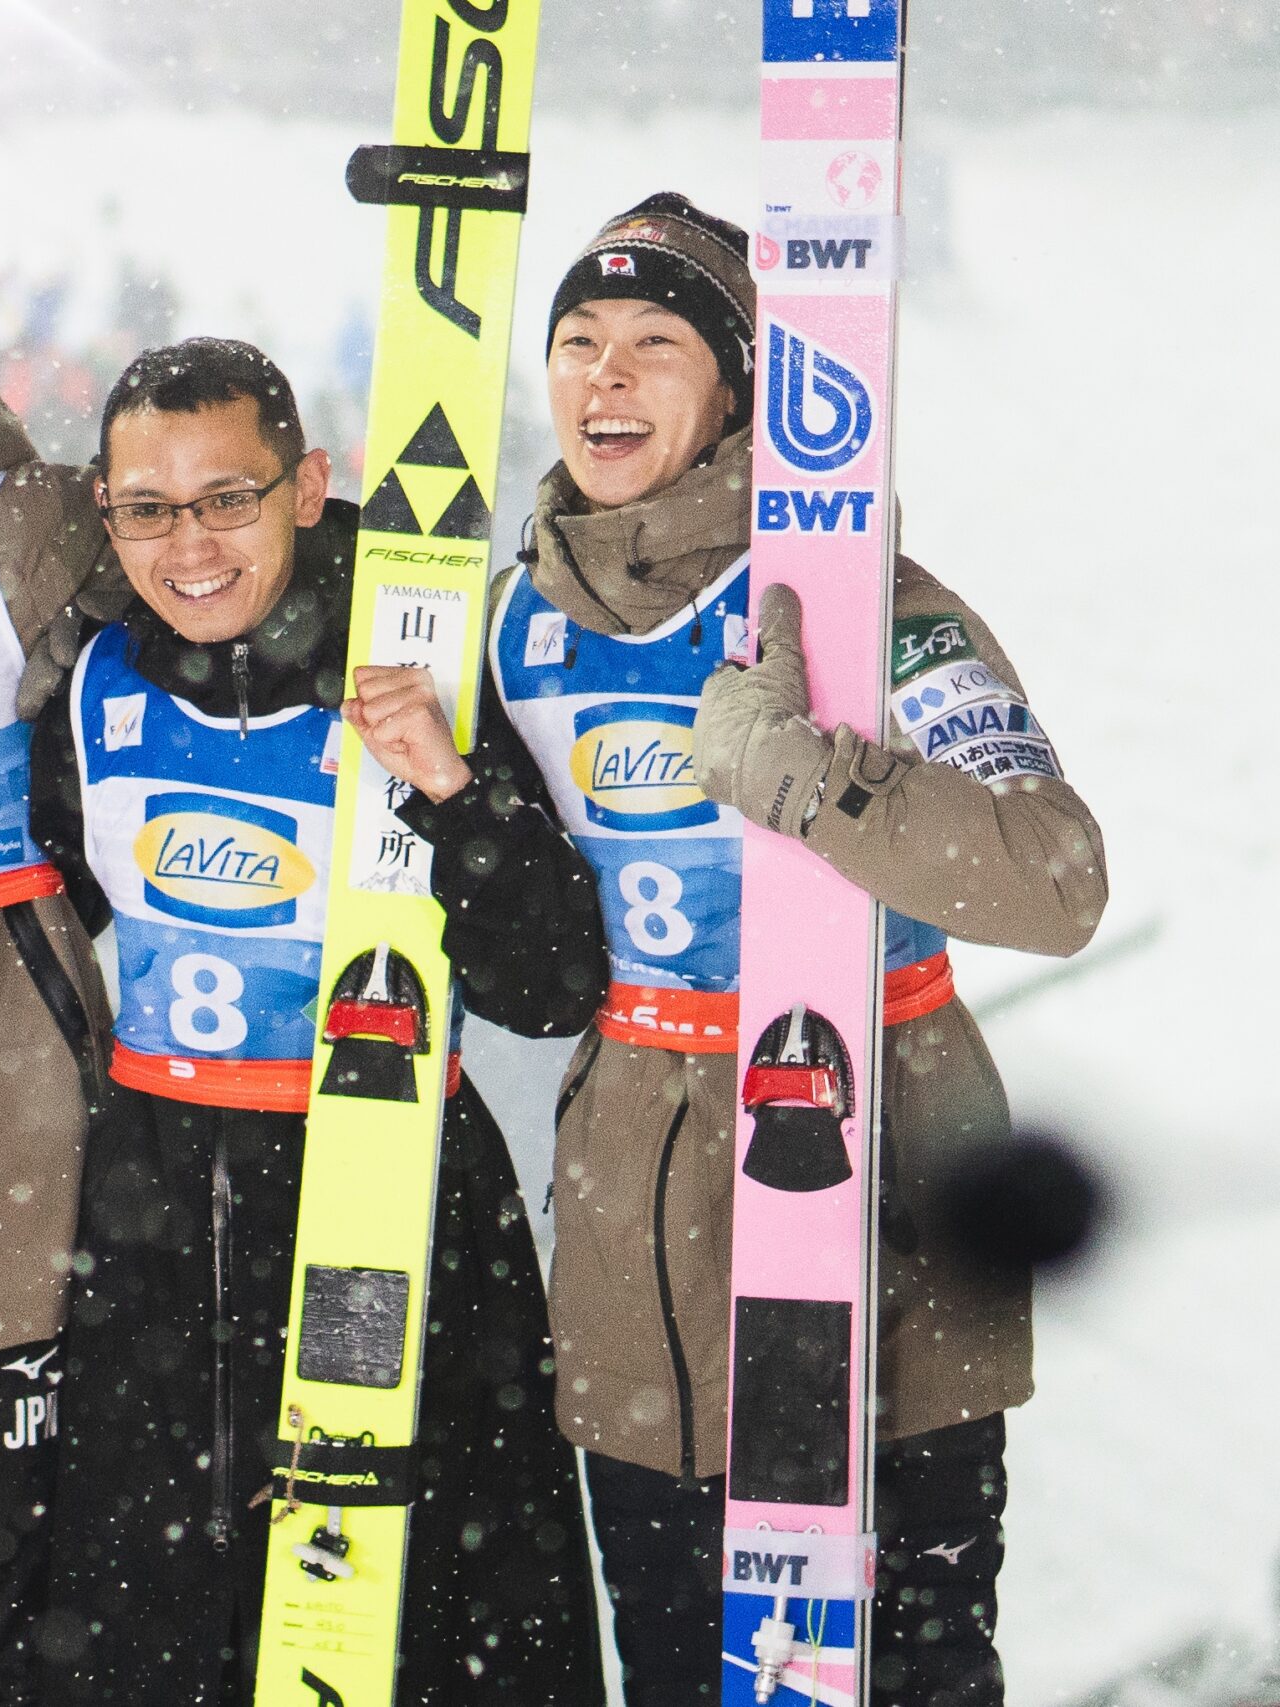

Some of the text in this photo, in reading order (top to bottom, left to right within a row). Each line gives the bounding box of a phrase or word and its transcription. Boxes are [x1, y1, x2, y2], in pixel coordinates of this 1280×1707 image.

[398, 173, 498, 189] FISCHER
[787, 239, 872, 269] BWT
[758, 490, 874, 532] BWT
[364, 548, 484, 569] FISCHER
[382, 584, 462, 602] YAMAGATA
[927, 705, 1005, 758] ANA
[618, 861, 694, 956] 8
[170, 953, 248, 1052] 8
[733, 1549, 809, 1586] BWT
